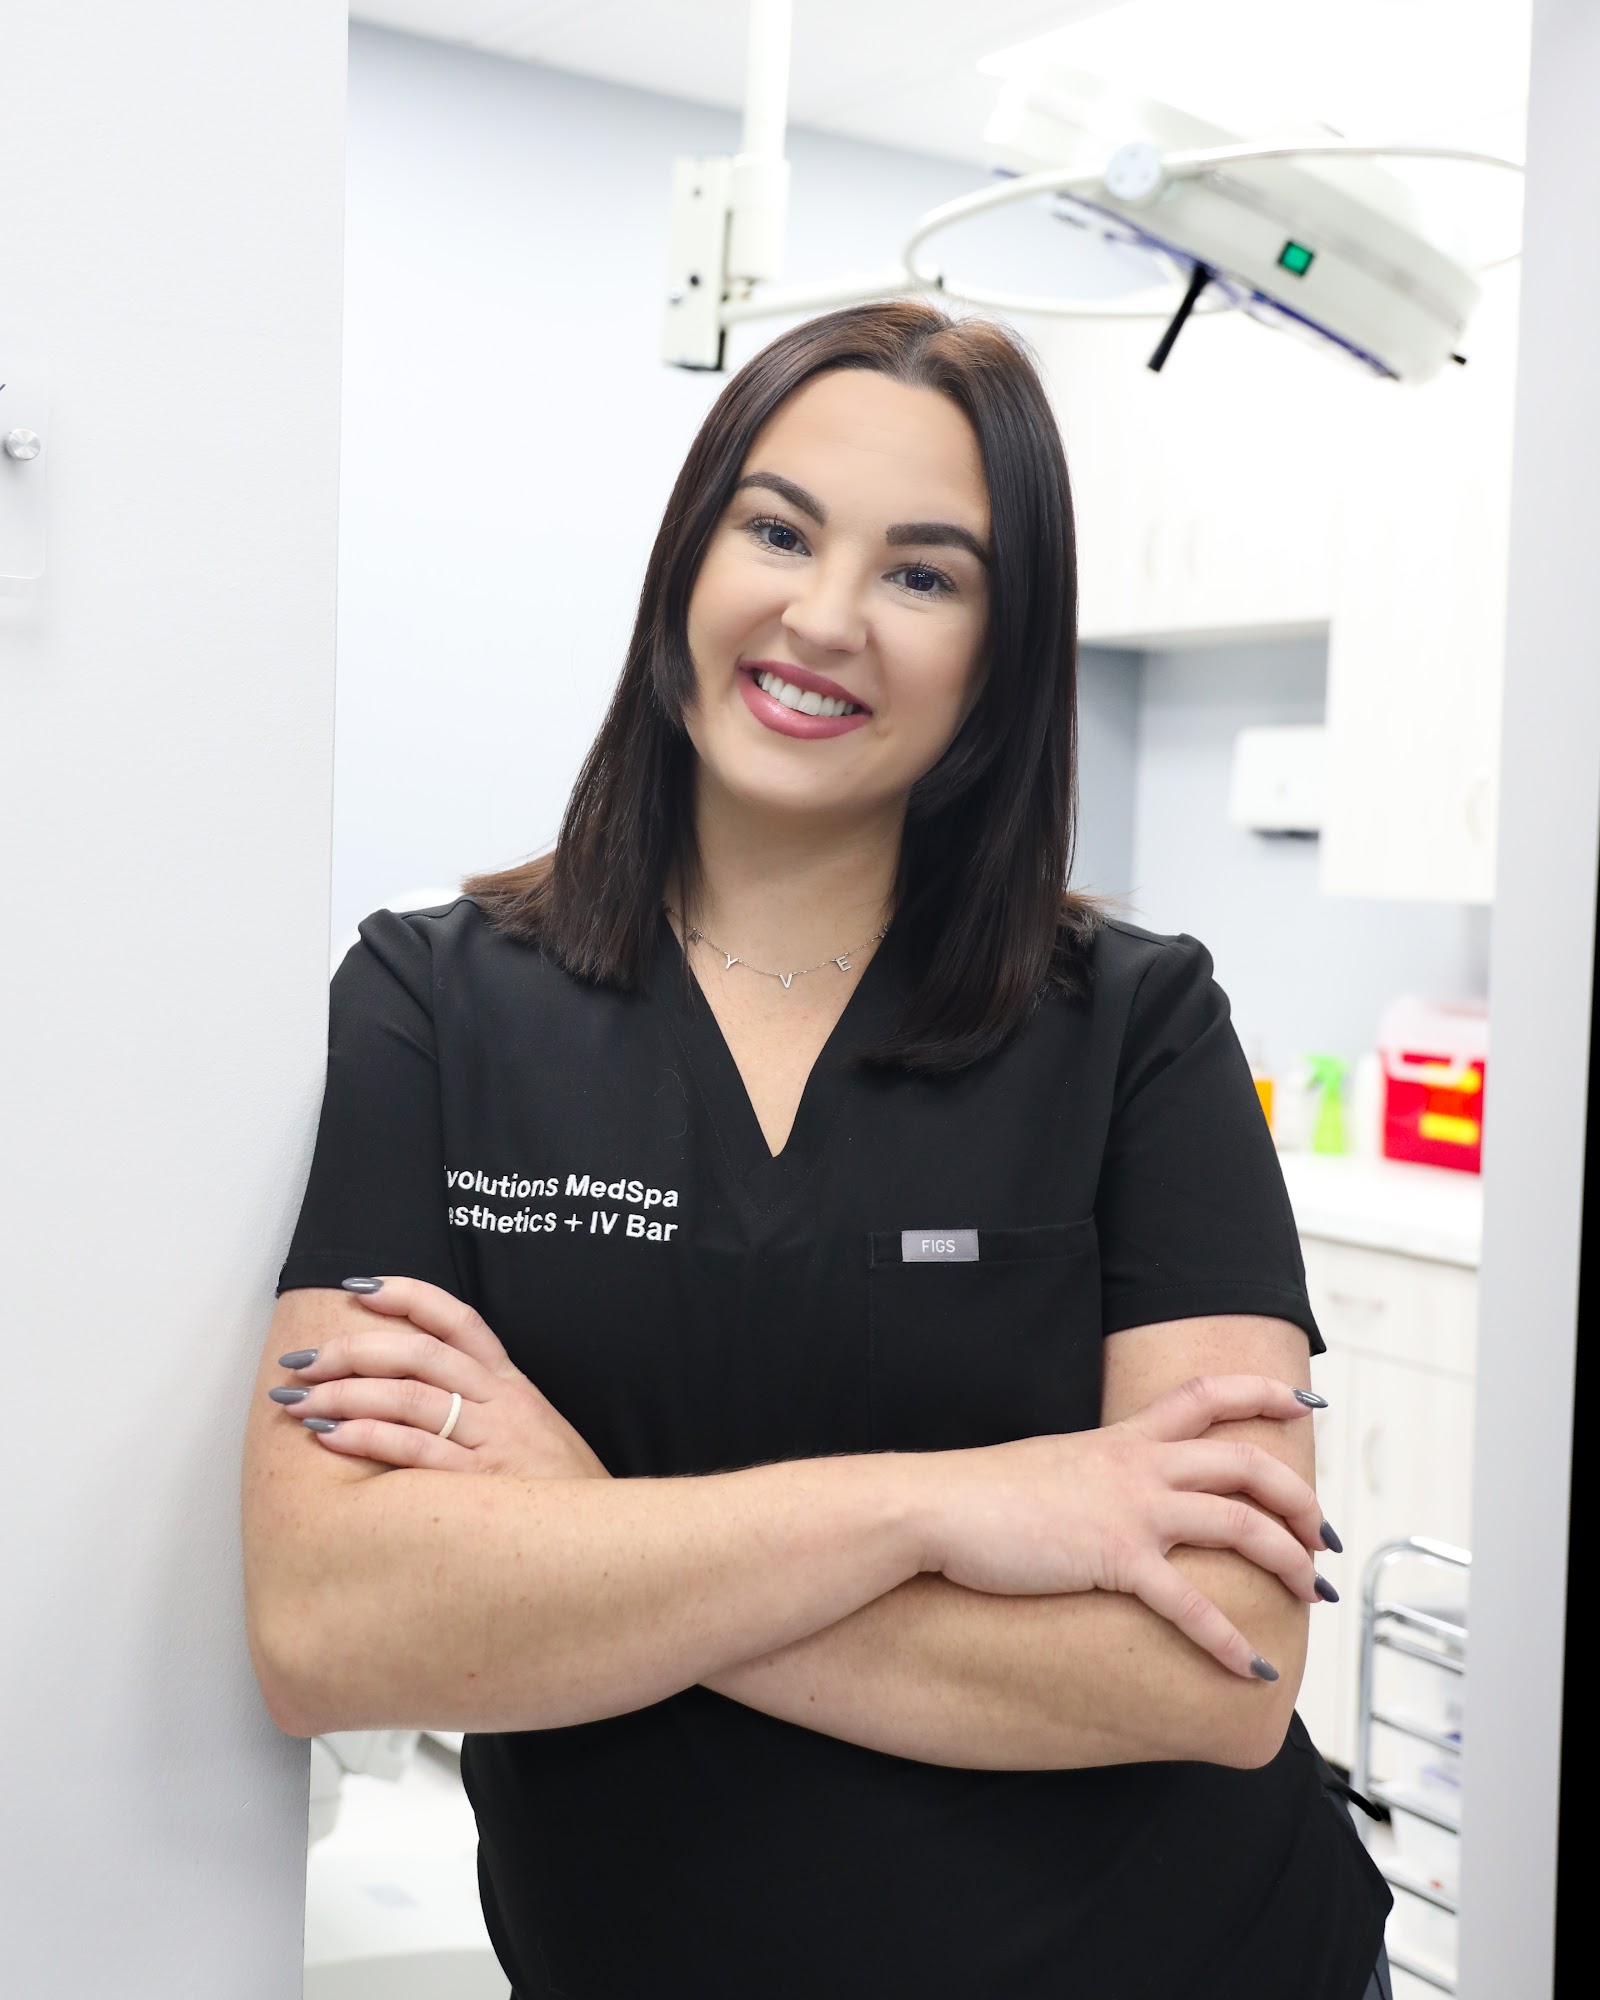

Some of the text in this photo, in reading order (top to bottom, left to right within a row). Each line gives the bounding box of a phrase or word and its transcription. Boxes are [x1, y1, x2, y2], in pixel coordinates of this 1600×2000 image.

[443, 1165, 679, 1210] volutions MedSpa
[589, 1210, 621, 1235] IV
[625, 1213, 679, 1242] Bar
[921, 1239, 956, 1253] FIGS
